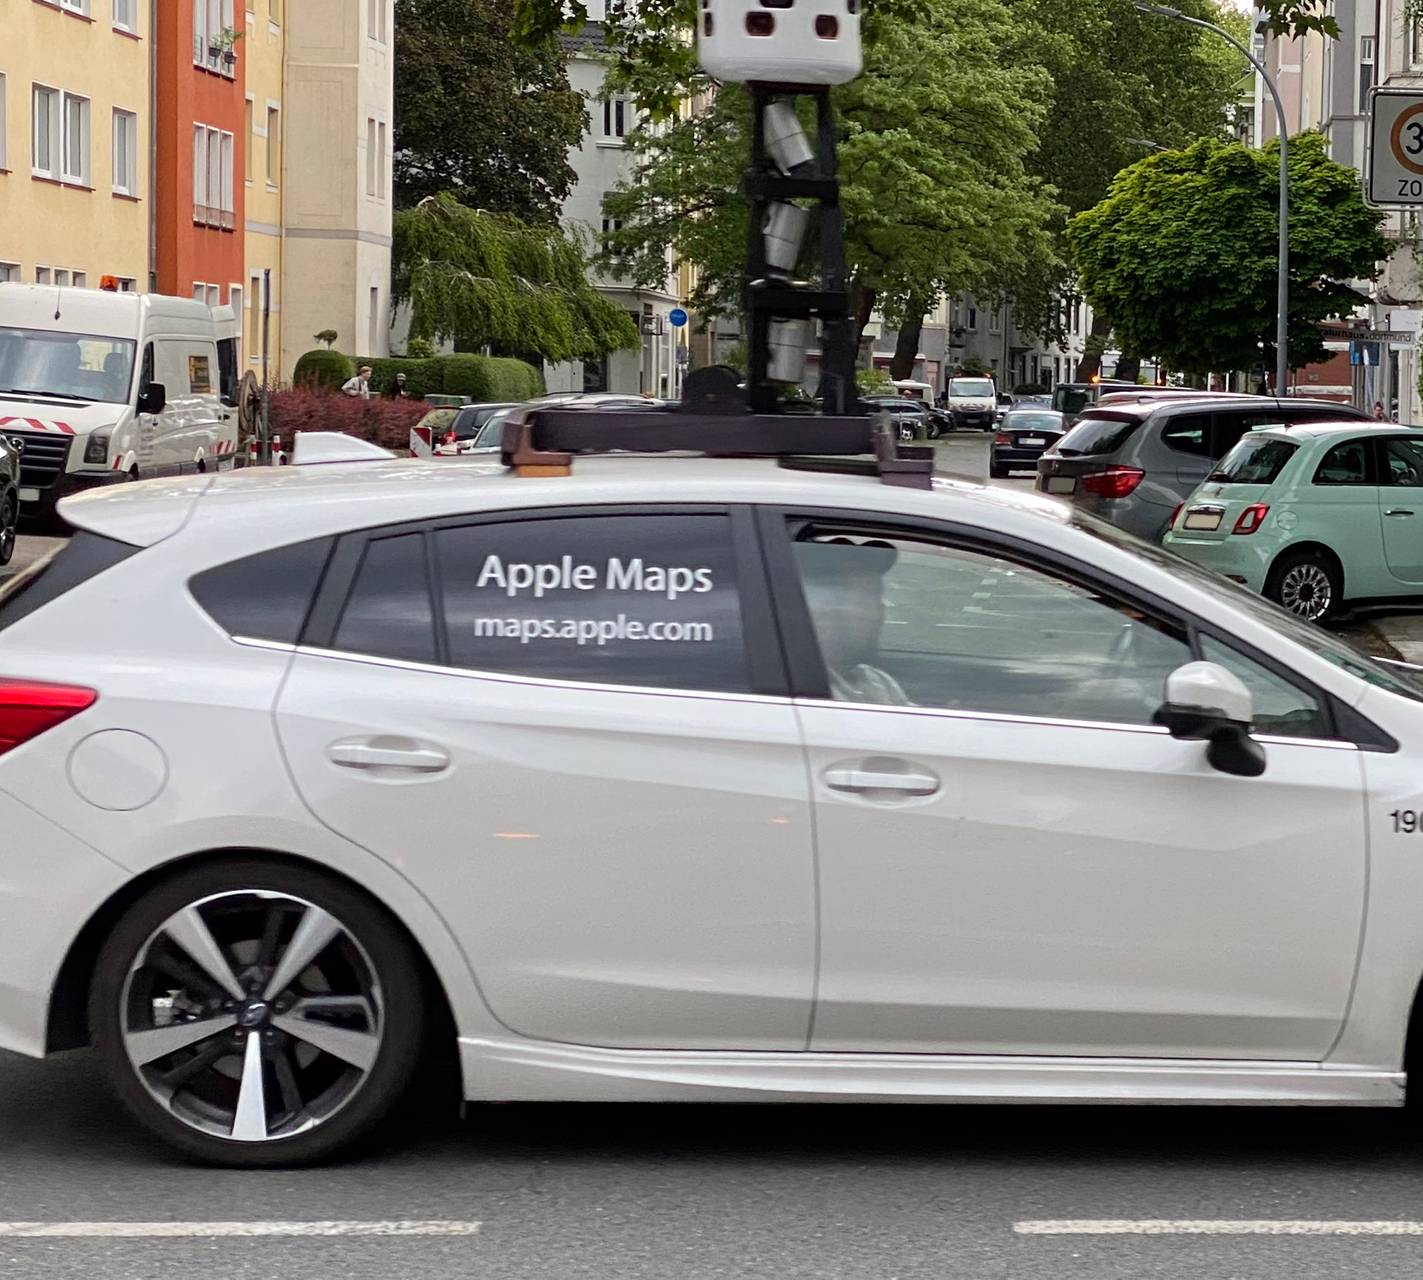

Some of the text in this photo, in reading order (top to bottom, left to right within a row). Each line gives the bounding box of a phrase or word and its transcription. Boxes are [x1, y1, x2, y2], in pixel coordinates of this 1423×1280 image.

[475, 554, 713, 601] Apple Maps
[474, 613, 714, 646] maps.apple.com
